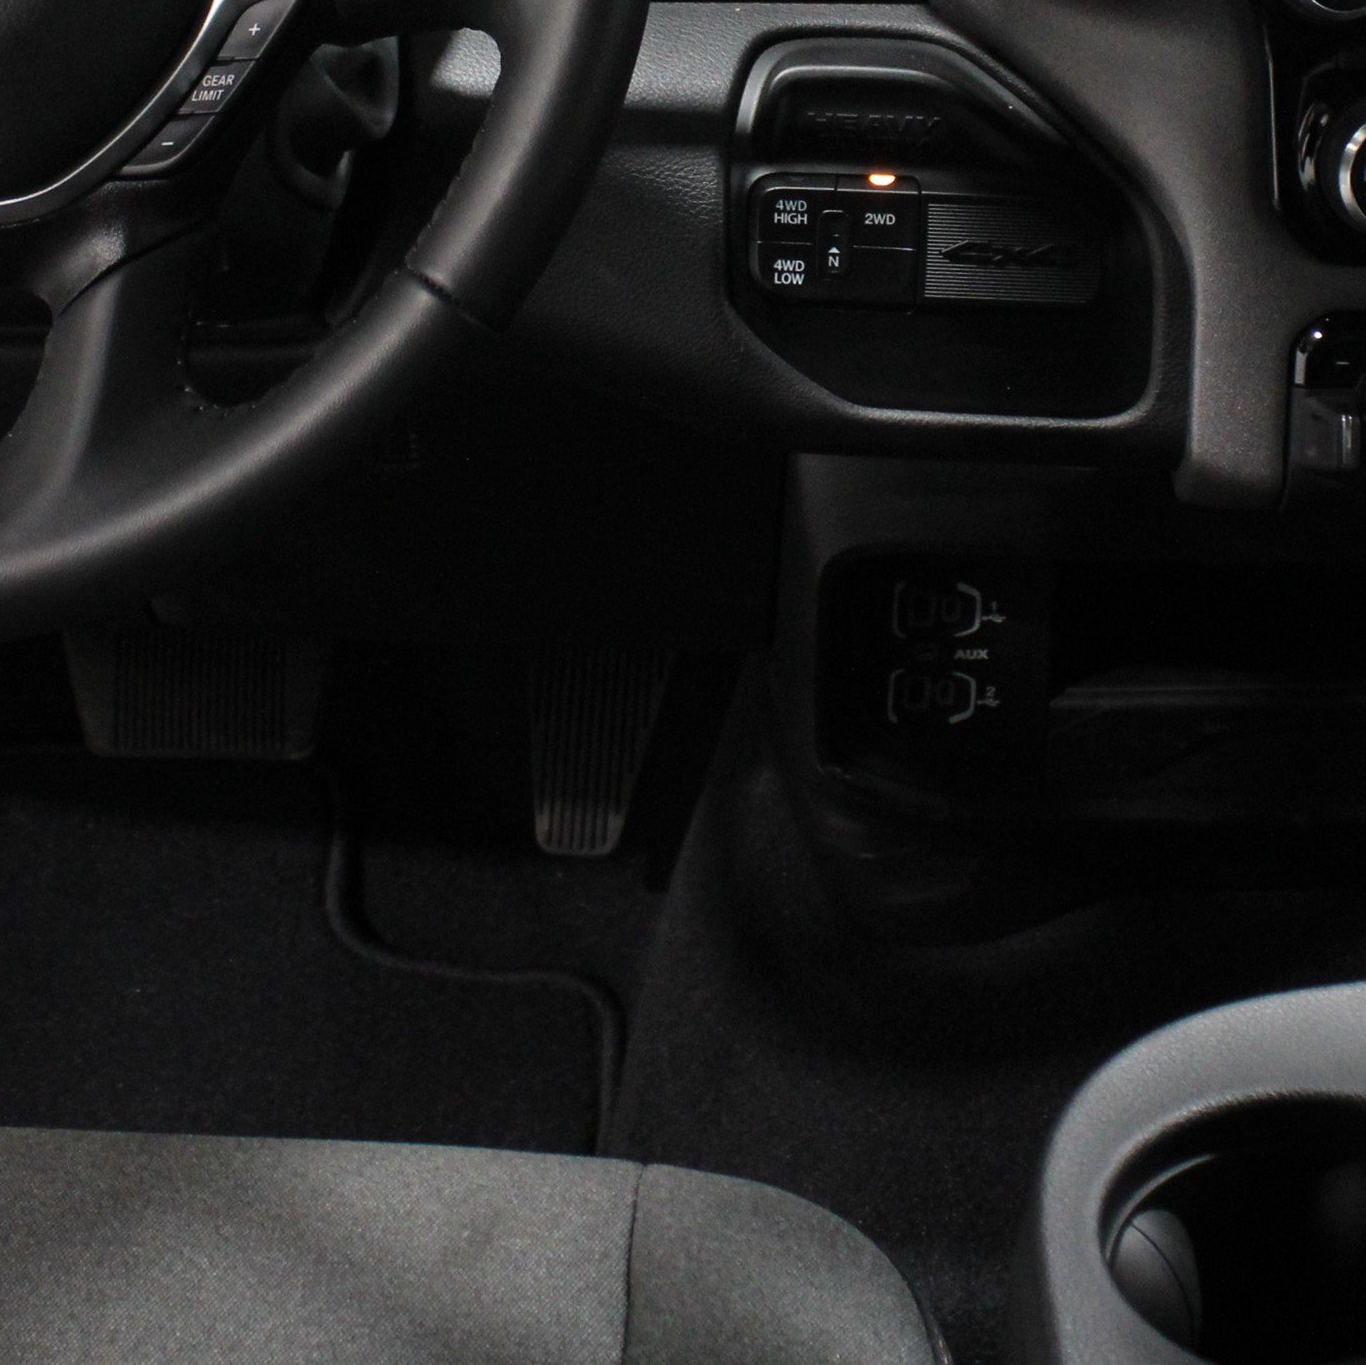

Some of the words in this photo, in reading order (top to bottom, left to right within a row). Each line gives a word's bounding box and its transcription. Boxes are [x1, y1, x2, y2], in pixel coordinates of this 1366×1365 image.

[202, 74, 235, 87] GEAR
[191, 89, 225, 102] LIMIT
[775, 199, 808, 212] 4WD
[774, 212, 808, 225] HIGH
[864, 212, 896, 226] 2WD
[773, 259, 805, 272] 4WD
[828, 255, 839, 267] N
[773, 272, 805, 285] LOW
[954, 648, 989, 660] AUX
